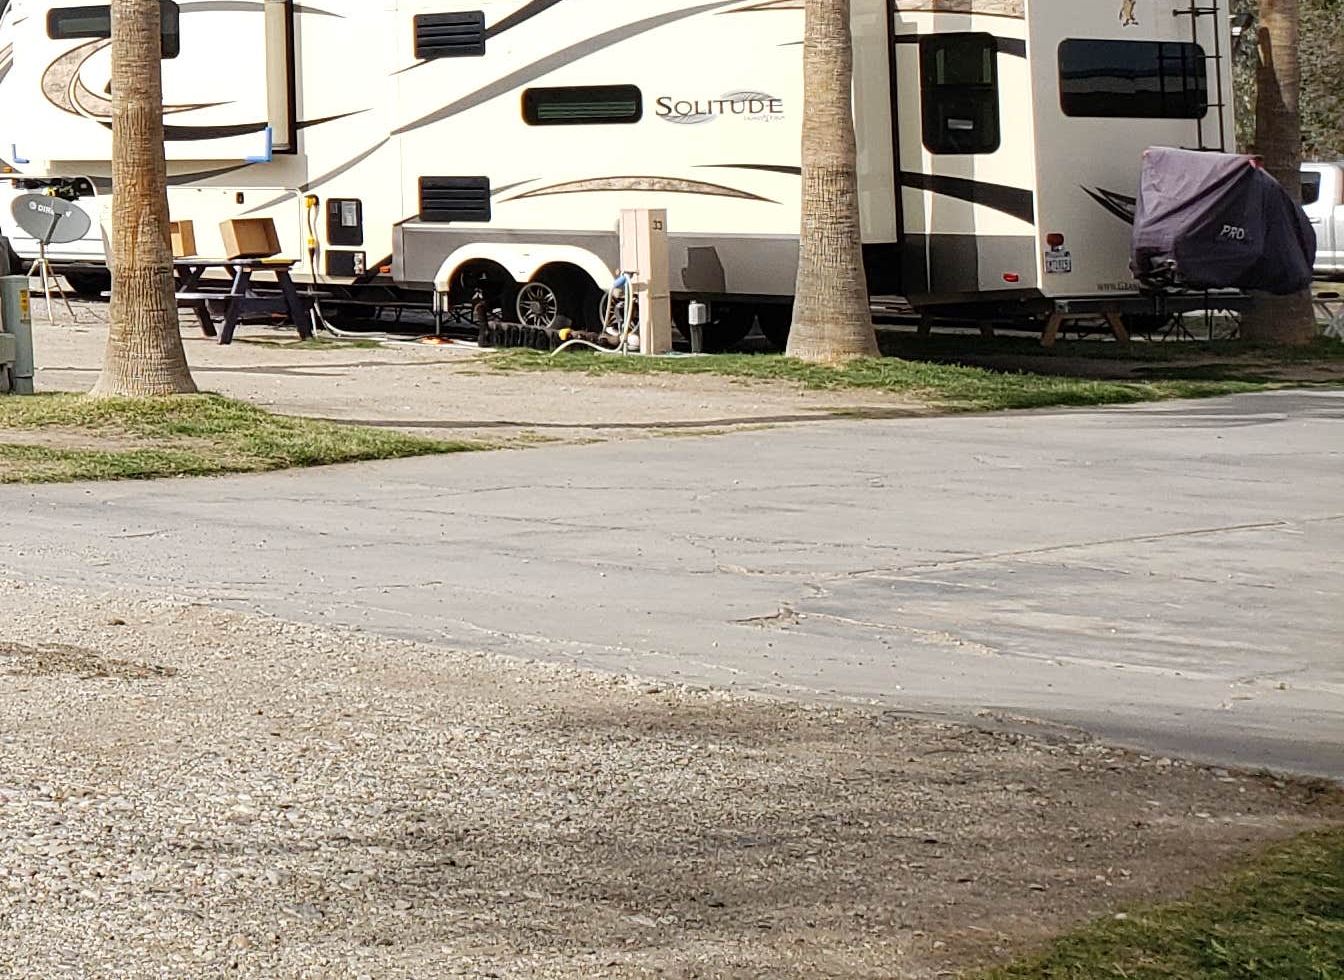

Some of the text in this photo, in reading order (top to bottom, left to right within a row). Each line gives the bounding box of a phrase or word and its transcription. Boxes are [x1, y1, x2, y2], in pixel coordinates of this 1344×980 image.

[656, 96, 783, 116] SOLITUDE
[653, 220, 663, 230] 33
[1220, 225, 1245, 239] PRO
